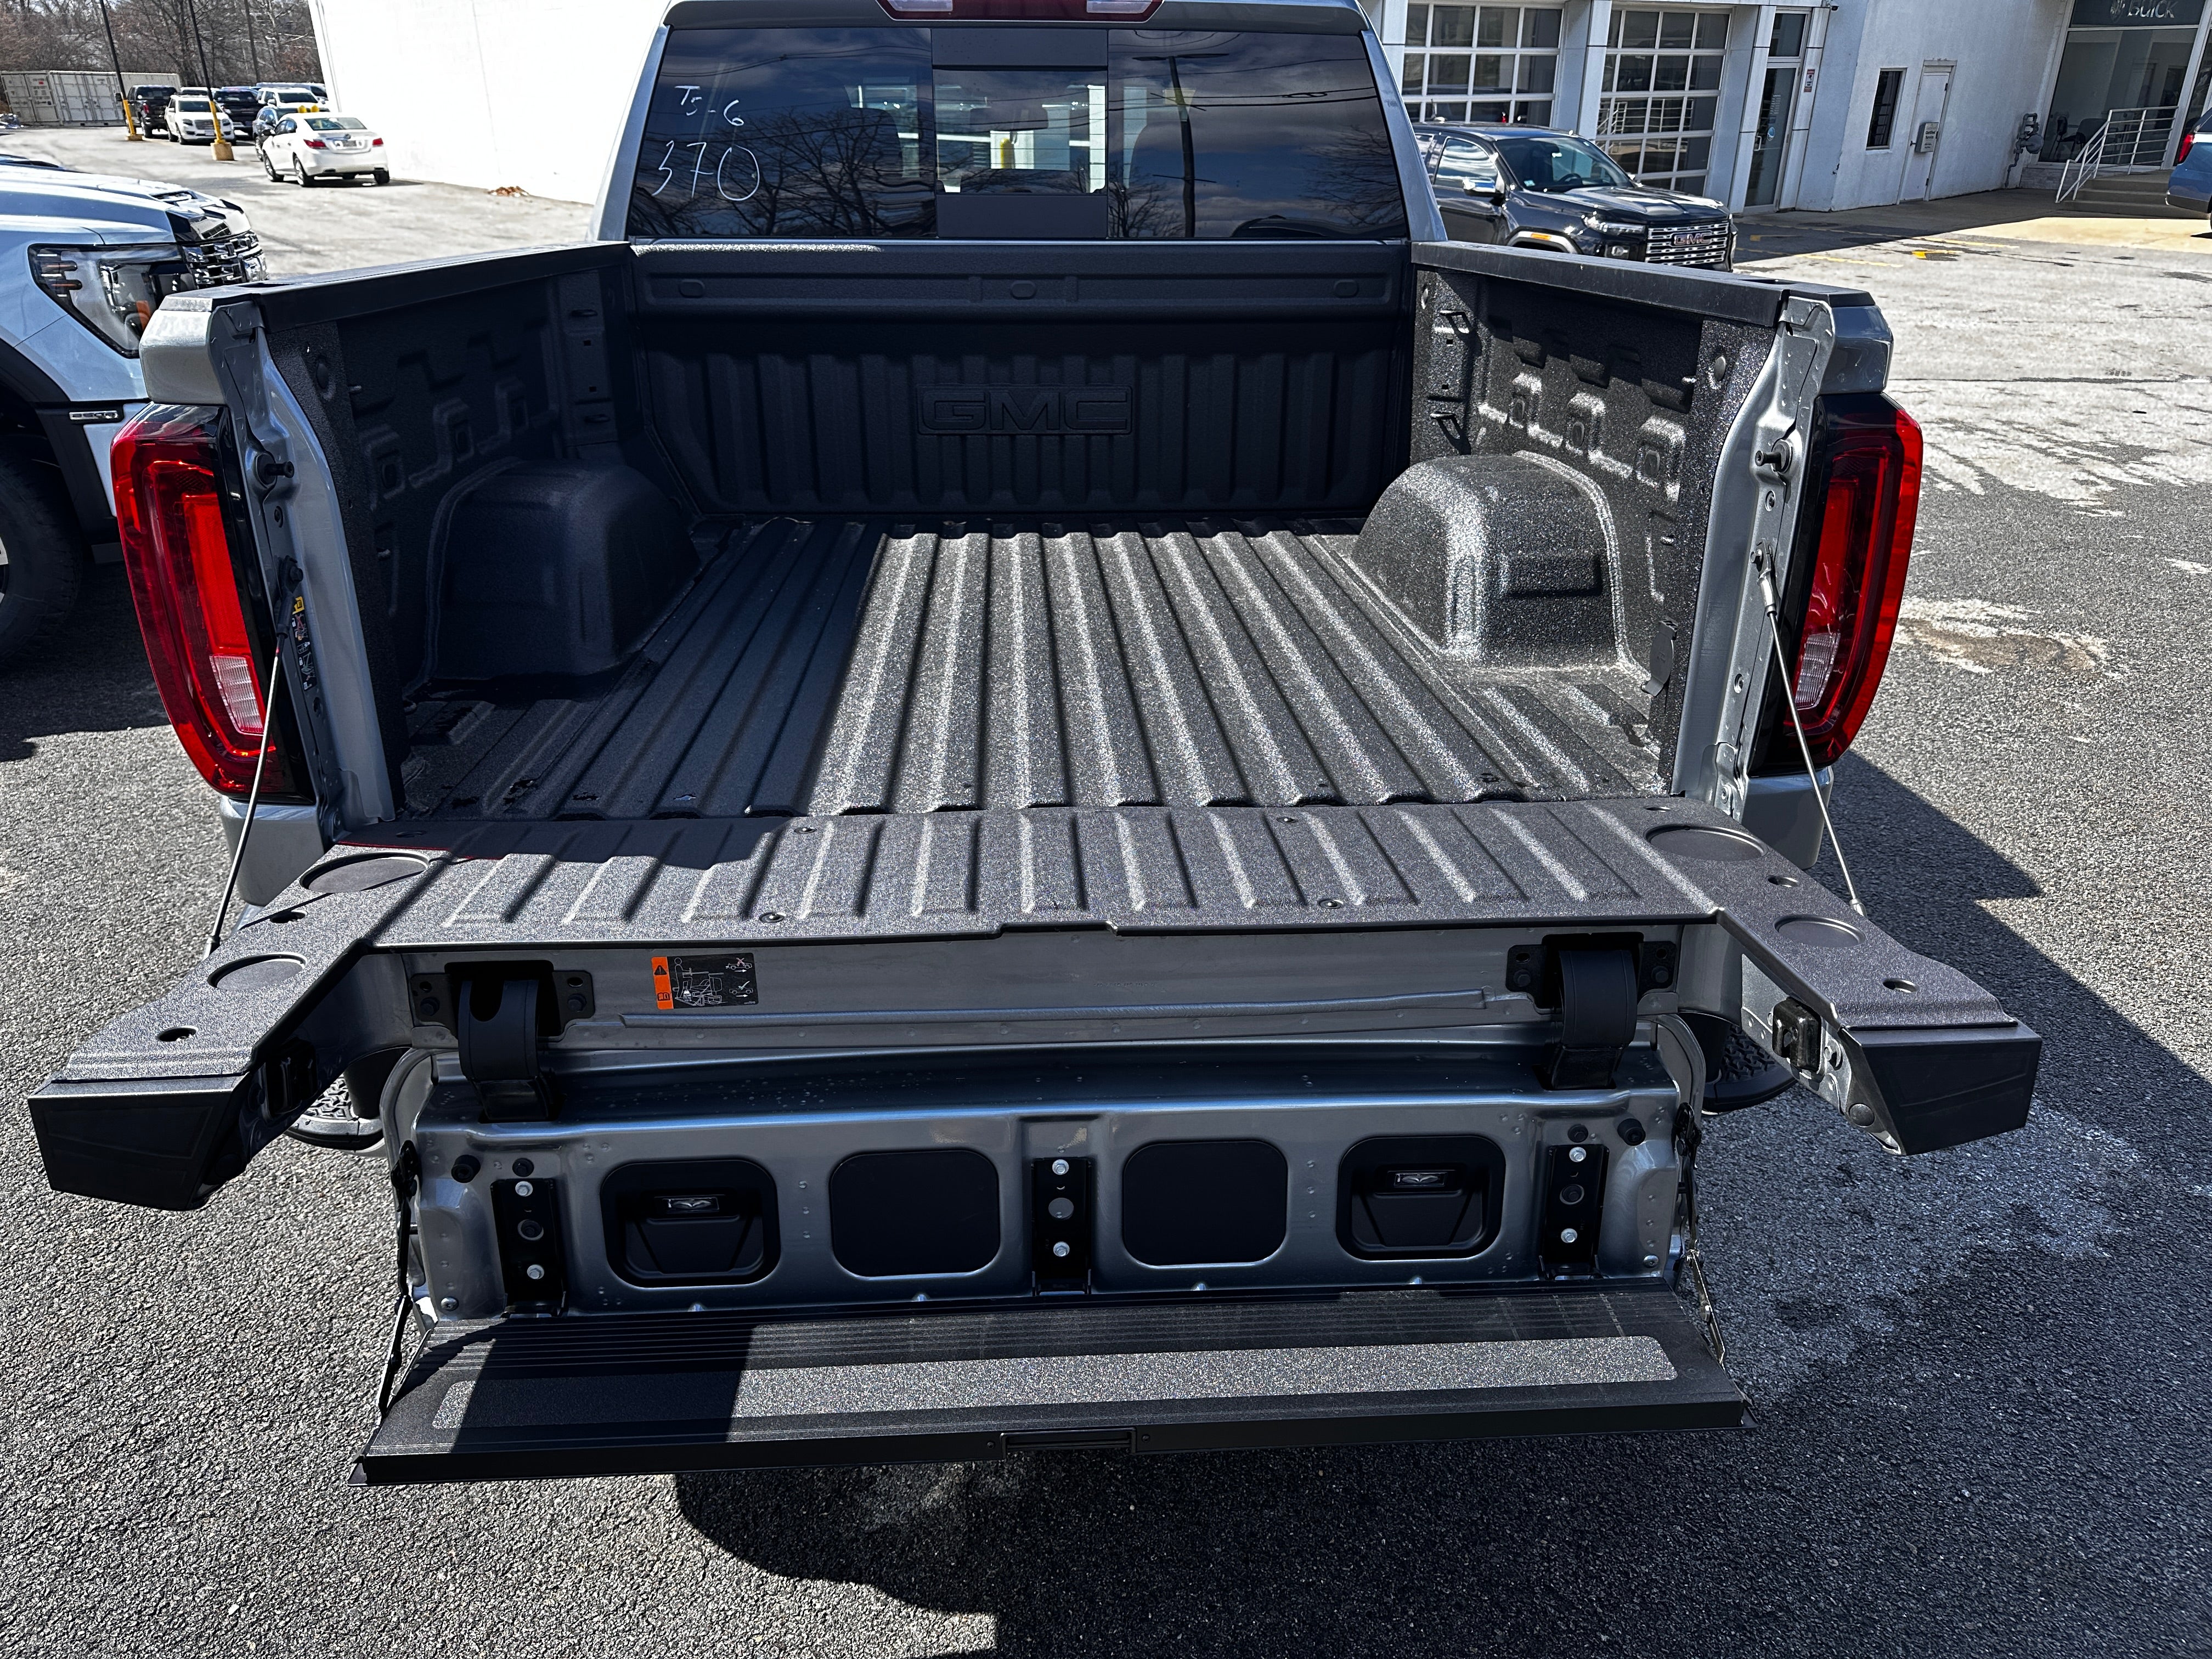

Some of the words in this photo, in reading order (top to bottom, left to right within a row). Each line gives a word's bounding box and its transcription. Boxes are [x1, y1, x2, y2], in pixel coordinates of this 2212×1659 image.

[651, 140, 760, 201] 370
[1673, 232, 1712, 246] GMC
[922, 390, 1128, 431] GMC
